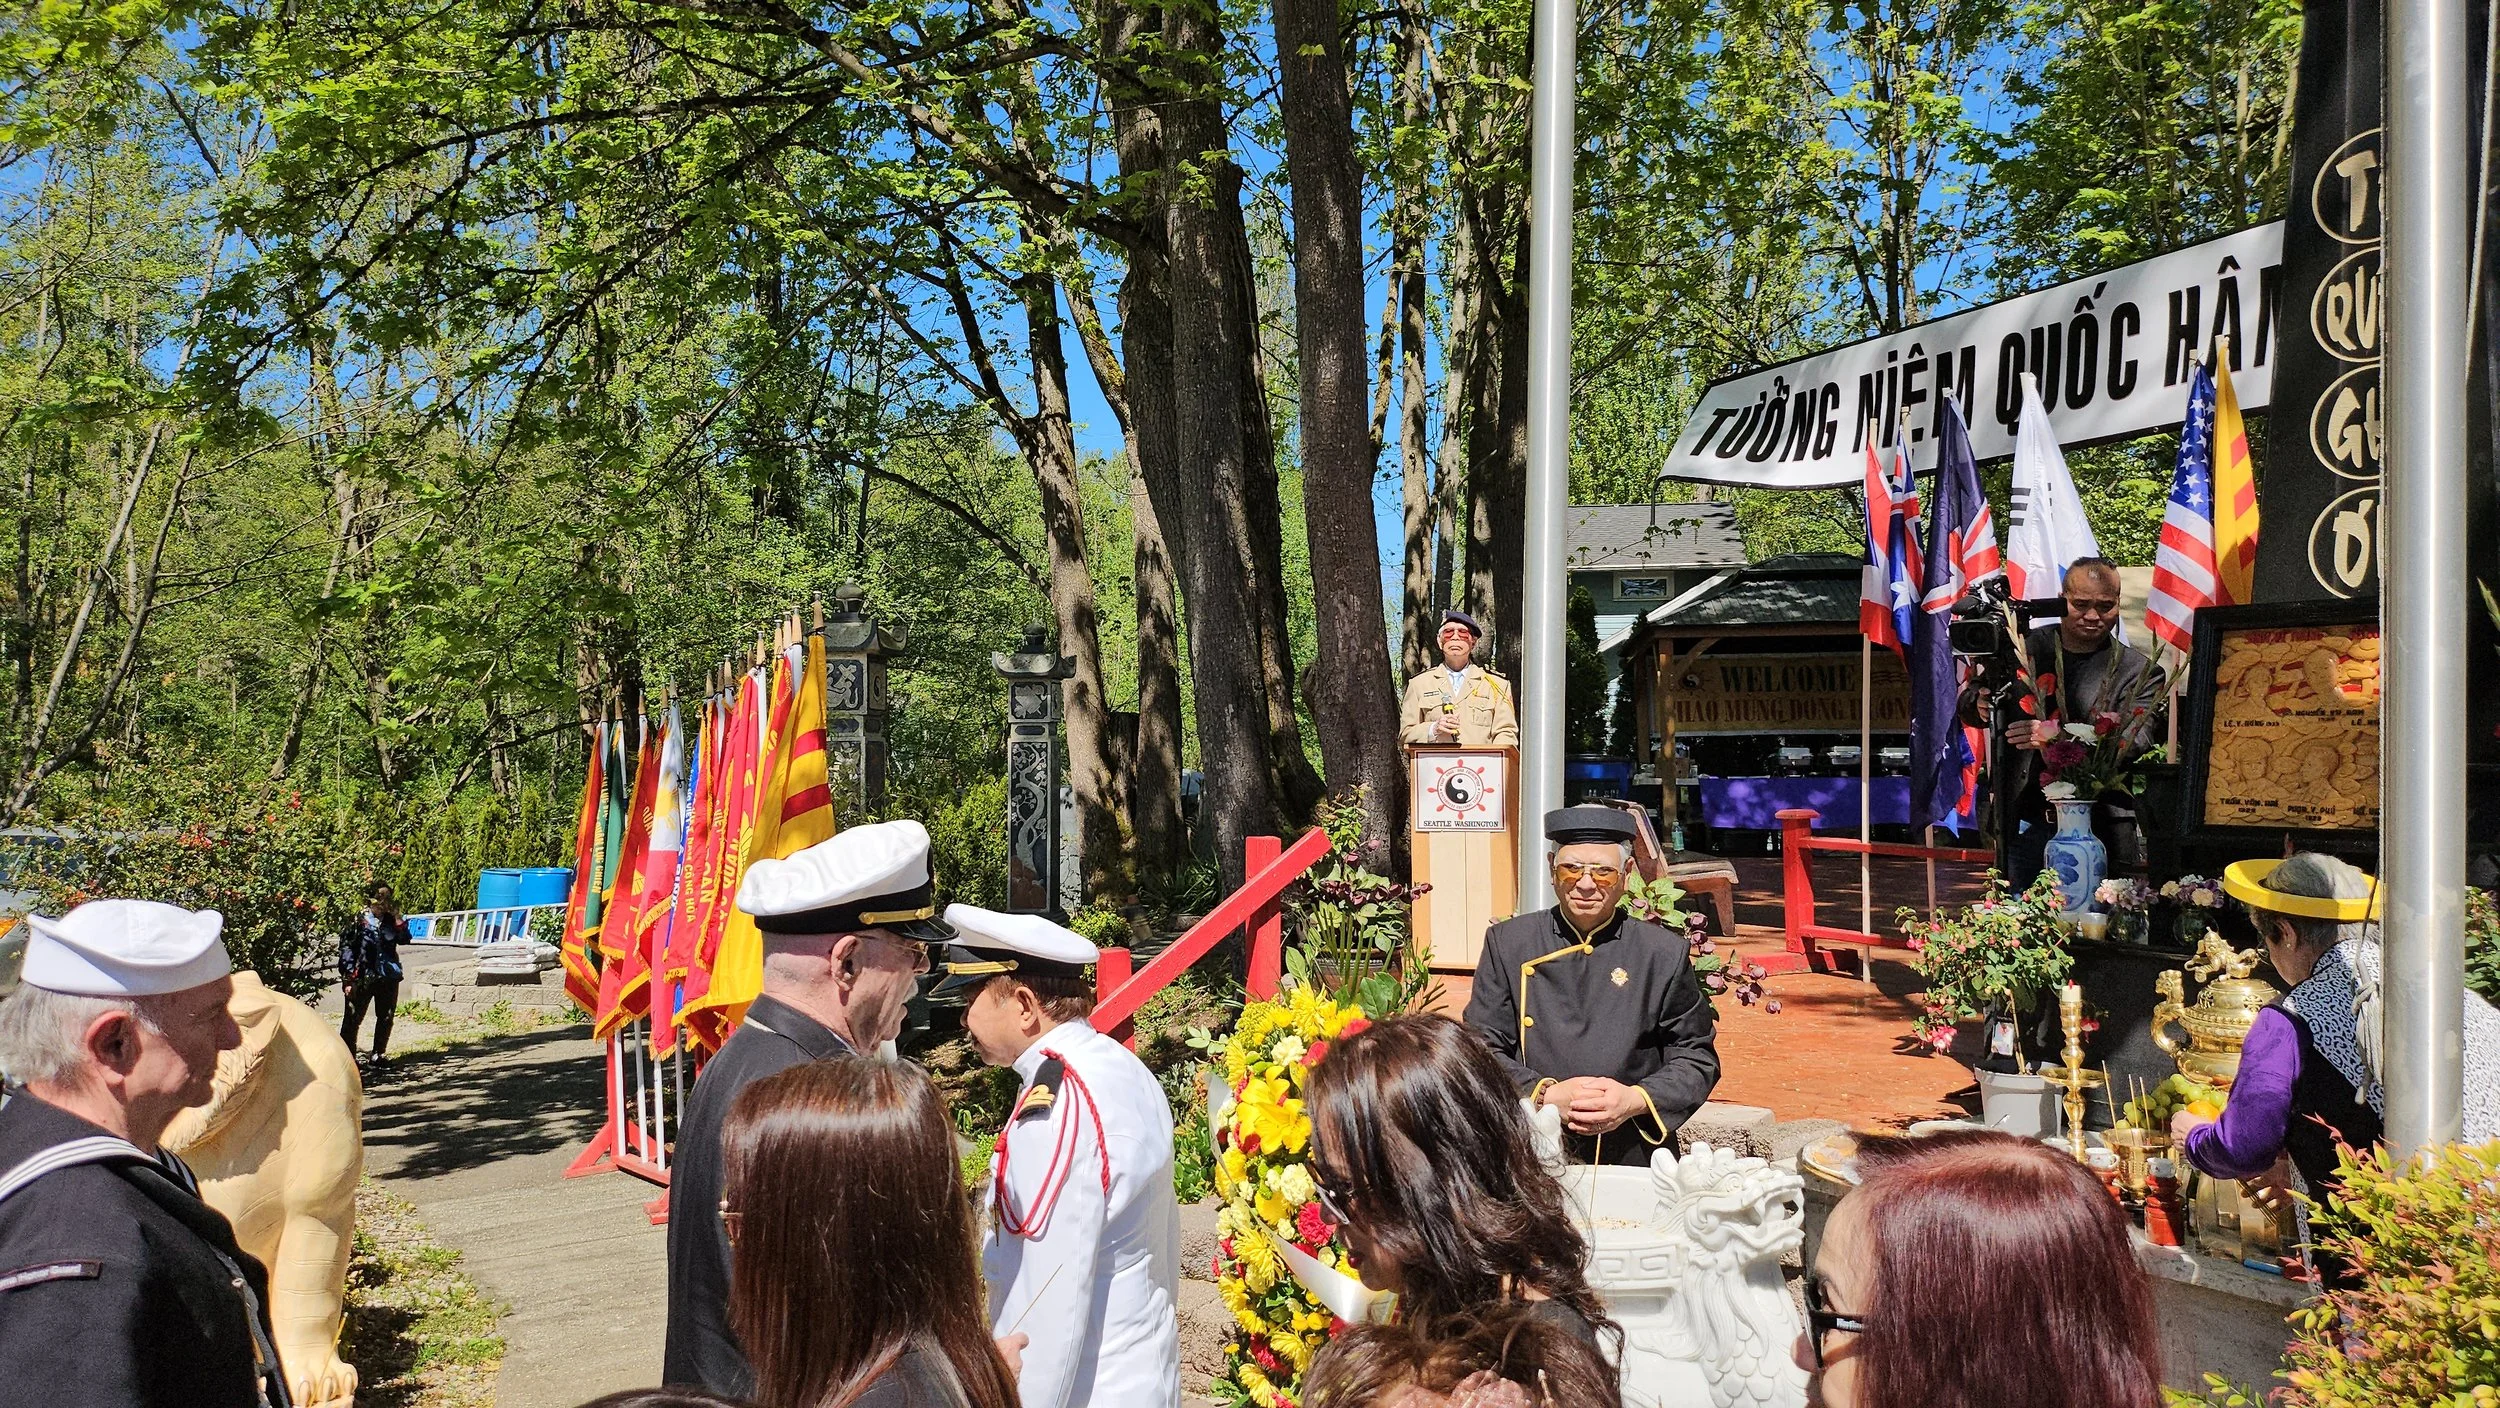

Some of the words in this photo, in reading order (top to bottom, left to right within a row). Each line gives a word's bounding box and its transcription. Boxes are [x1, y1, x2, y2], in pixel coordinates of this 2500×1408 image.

[2336, 150, 2384, 232] T
[1689, 375, 1840, 463] TƯỞNG
[1995, 281, 2141, 436] QUỐC
[1720, 665, 1856, 692] WELCOME
[1454, 820, 1499, 828] WASHINGTON
